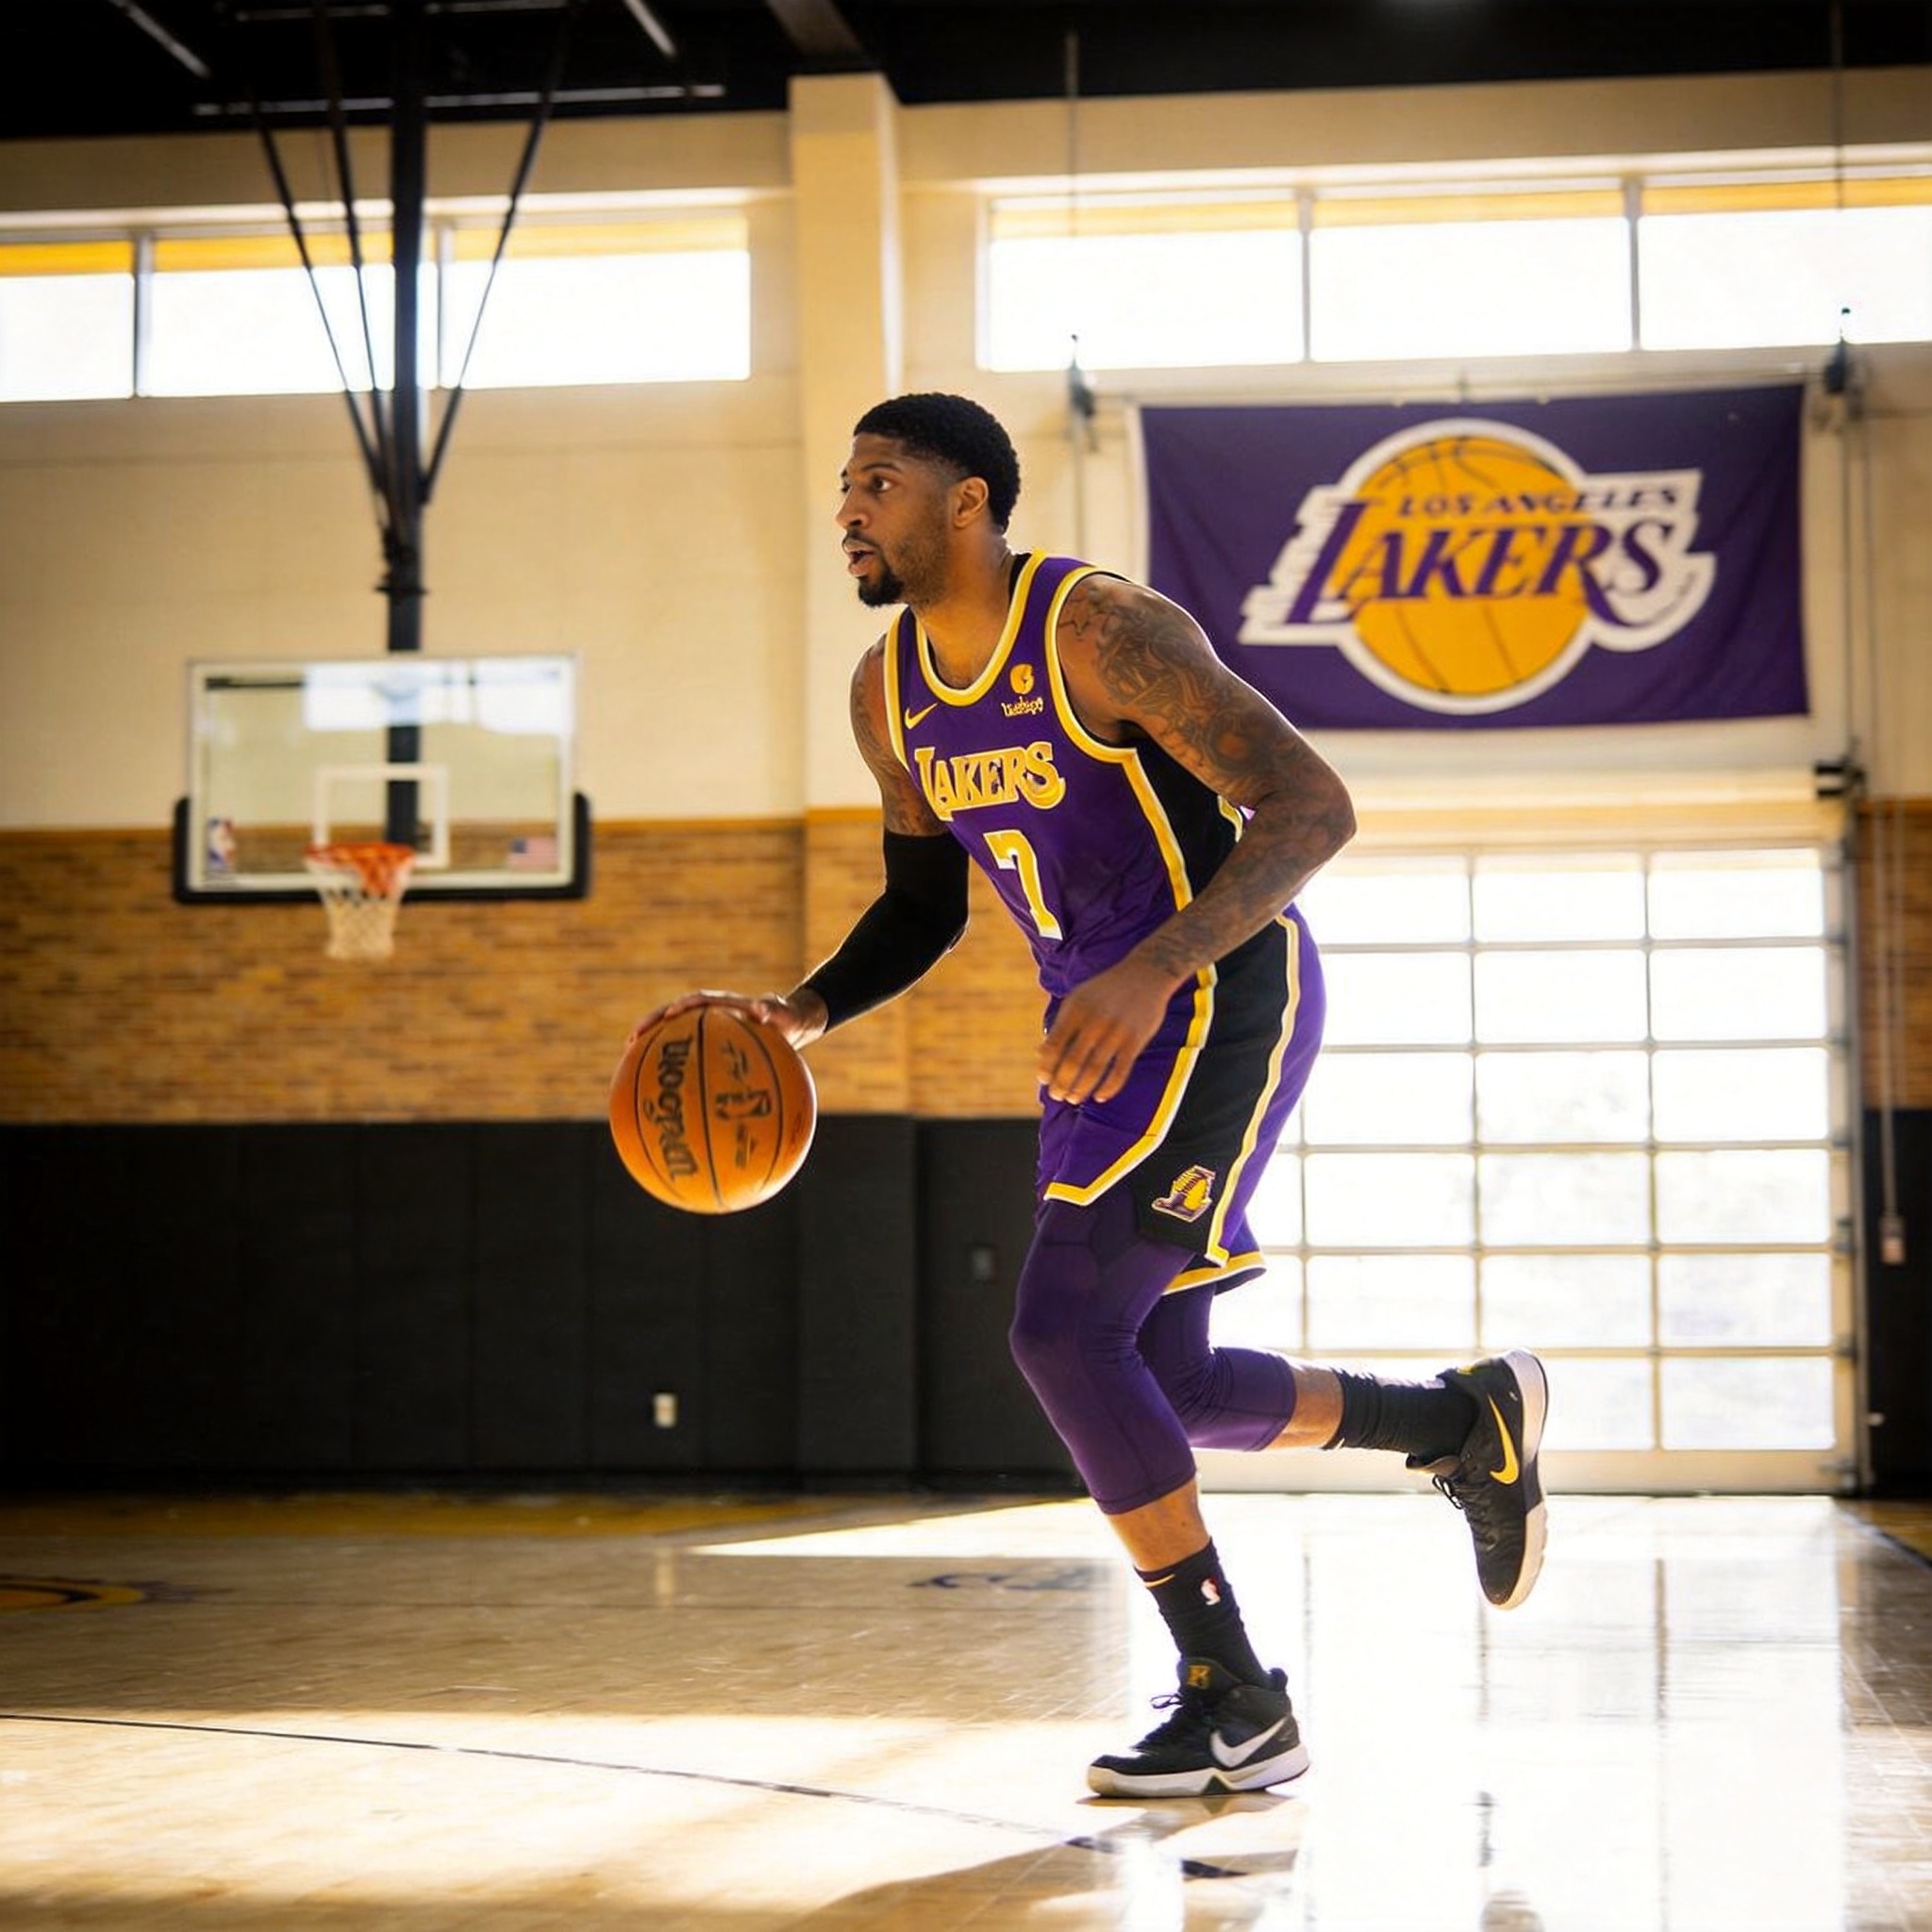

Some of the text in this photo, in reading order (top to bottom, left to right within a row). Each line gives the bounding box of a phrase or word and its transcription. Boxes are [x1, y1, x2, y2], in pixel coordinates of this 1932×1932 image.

[1398, 487, 1680, 517] LOS ANGELES
[1285, 499, 1700, 629] LAKERS
[914, 741, 1066, 822] LAKERS
[983, 829, 1063, 941] 7
